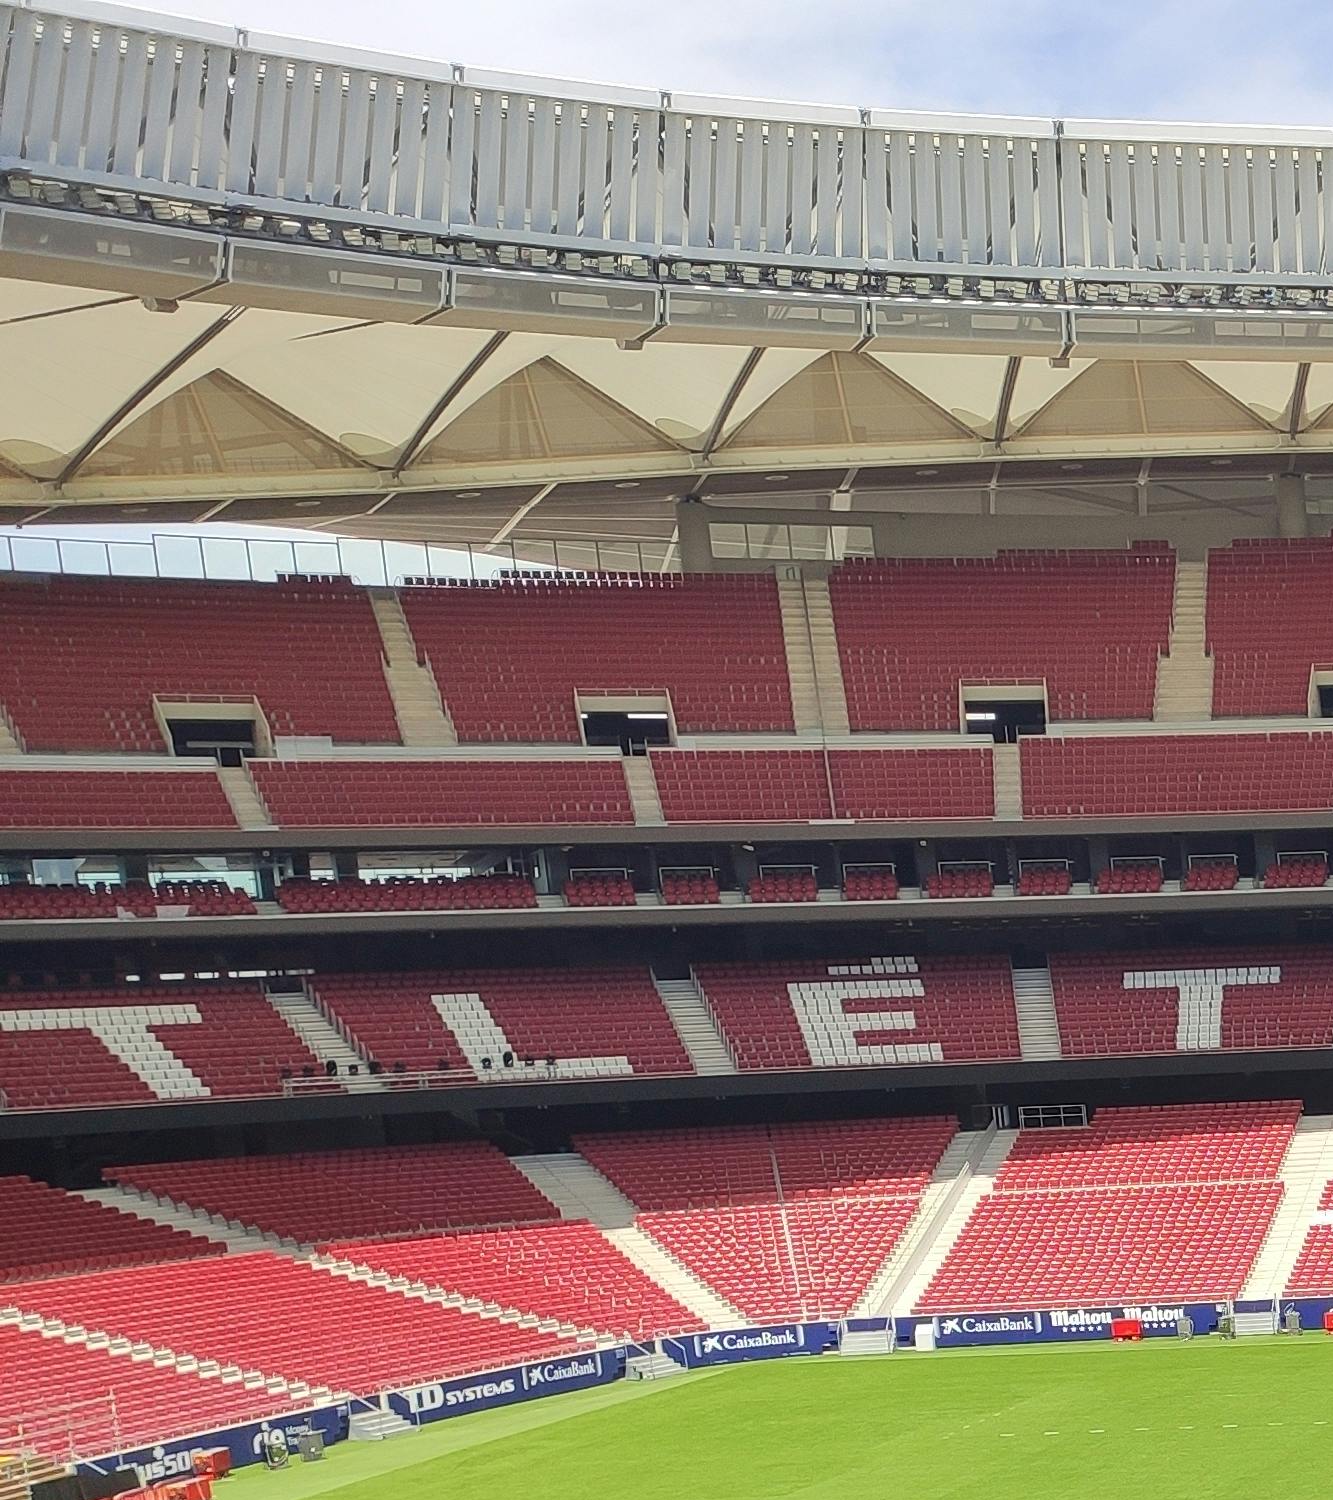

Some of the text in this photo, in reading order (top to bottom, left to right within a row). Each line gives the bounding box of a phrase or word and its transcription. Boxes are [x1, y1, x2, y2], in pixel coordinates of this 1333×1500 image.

[962, 1318, 1034, 1333] CaixaBank
[1050, 1310, 1112, 1326] Mahou
[722, 1329, 797, 1350] CaixaBank
[544, 1358, 596, 1382] CaixaBank
[405, 1379, 516, 1413] TD SYSTEMS
